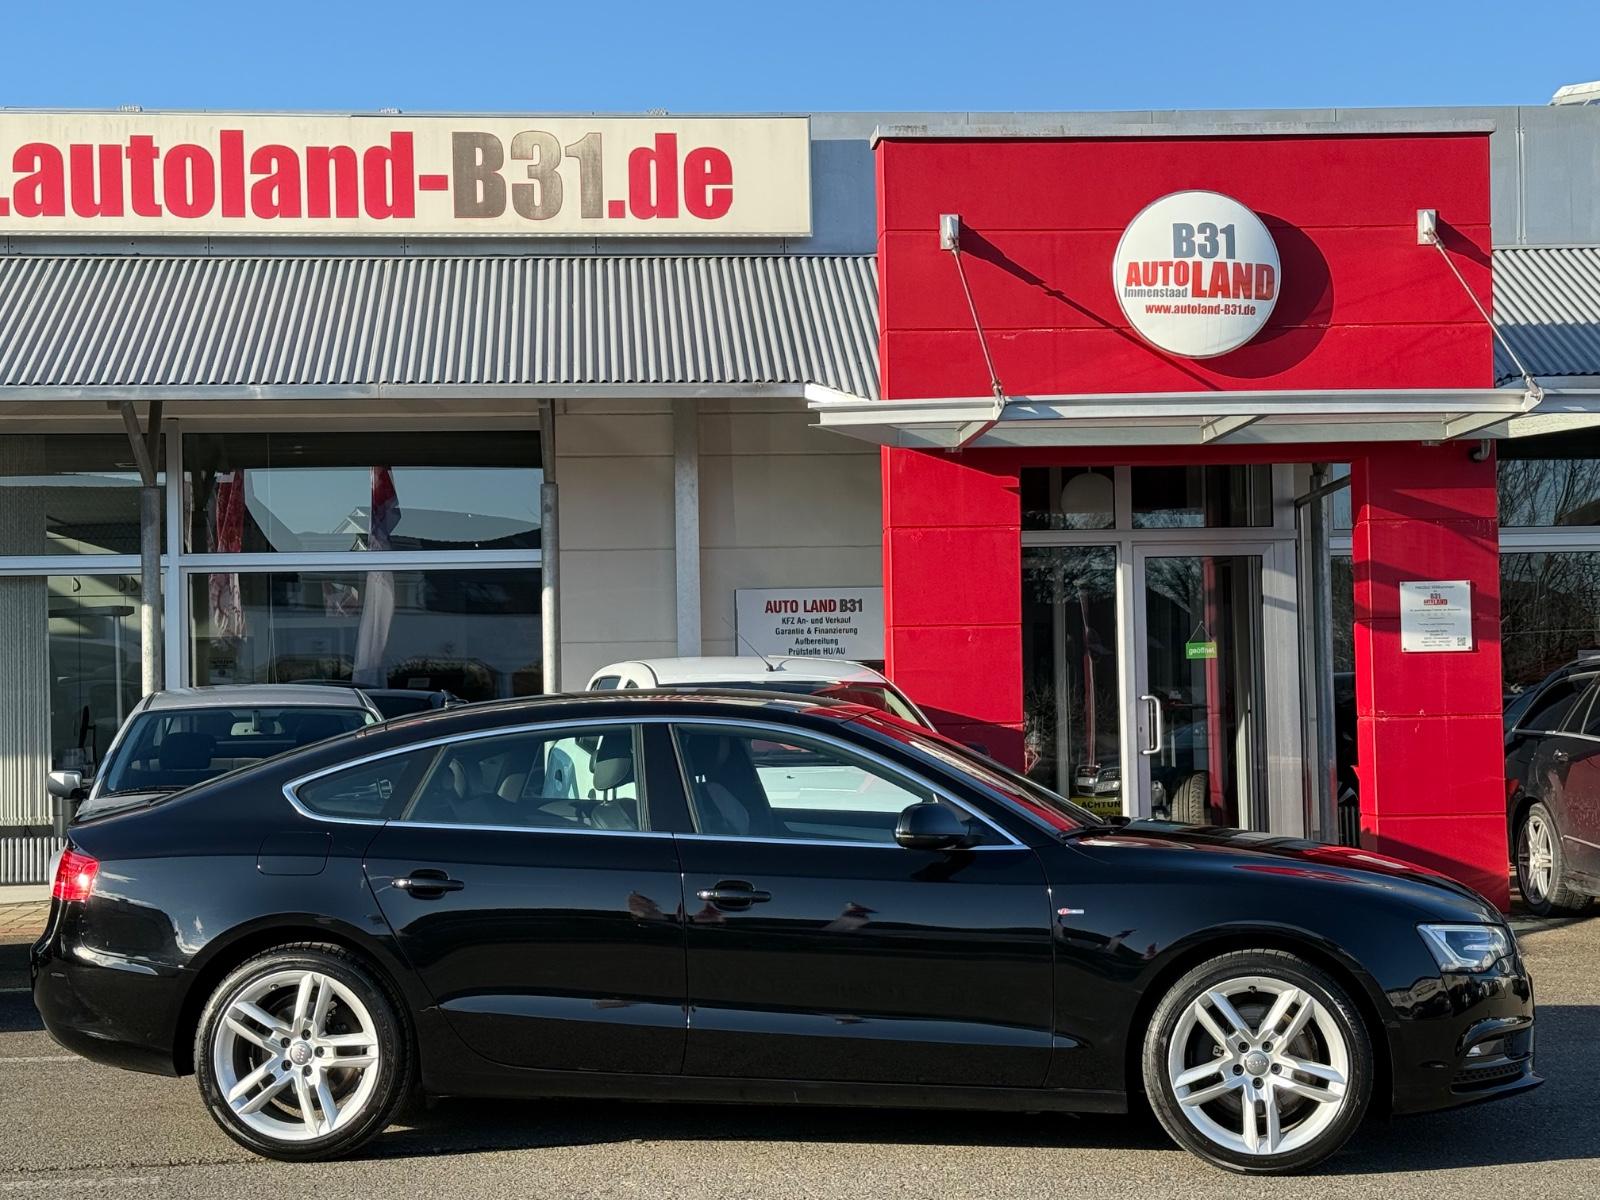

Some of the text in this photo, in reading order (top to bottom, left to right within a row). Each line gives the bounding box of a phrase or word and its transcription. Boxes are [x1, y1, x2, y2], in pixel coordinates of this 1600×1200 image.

[1172, 222, 1236, 260] B31
[1124, 287, 1188, 298] Immenstaad
[1145, 303, 1256, 315] www.autoland-B31.de
[764, 598, 863, 614] AUTO LAND B31
[782, 616, 851, 625] KFZ An- und Verkauf
[775, 627, 858, 635] Garantie & Finanzierung
[795, 637, 839, 646] Aufbereitung
[823, 647, 846, 655] HU/AU
